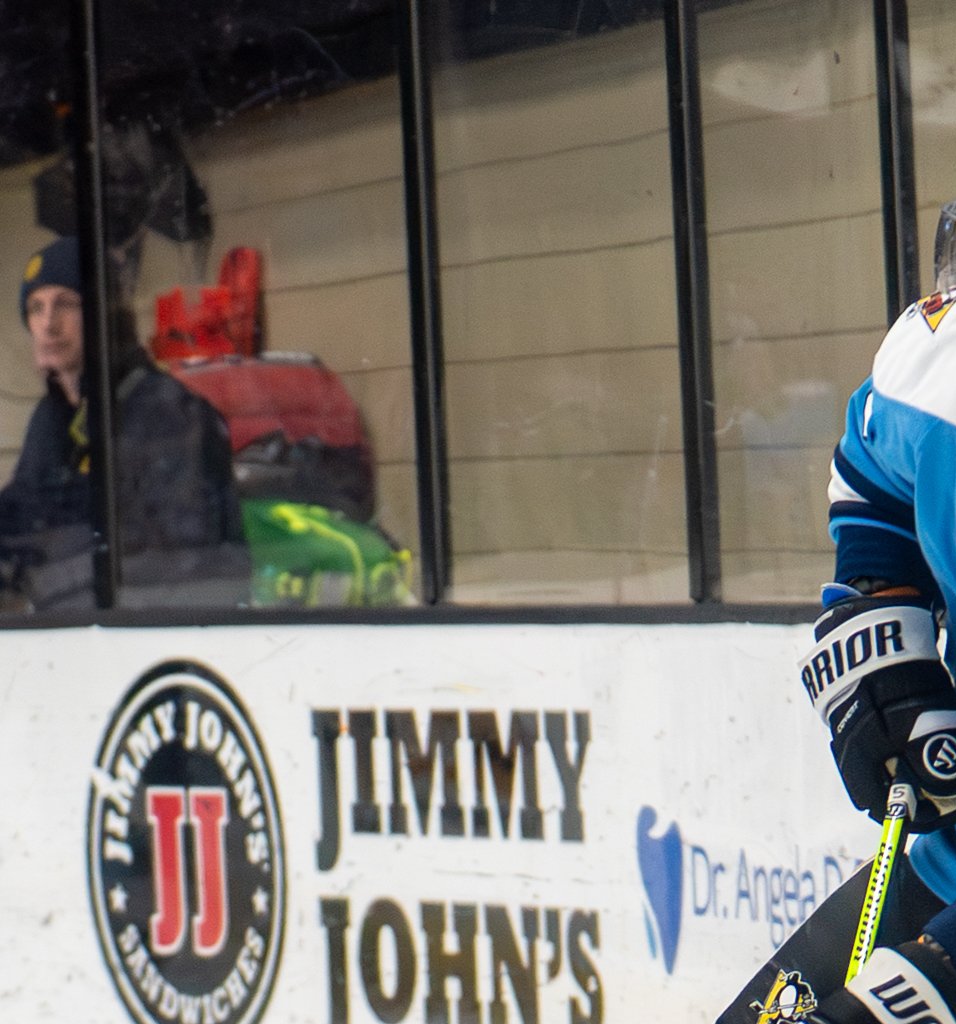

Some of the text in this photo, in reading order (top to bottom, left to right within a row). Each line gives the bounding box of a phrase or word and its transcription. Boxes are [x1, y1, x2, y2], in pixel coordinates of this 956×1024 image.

[146, 786, 228, 957] JJ
[311, 708, 592, 872] JIMMY
[691, 845, 728, 918] Dr.
